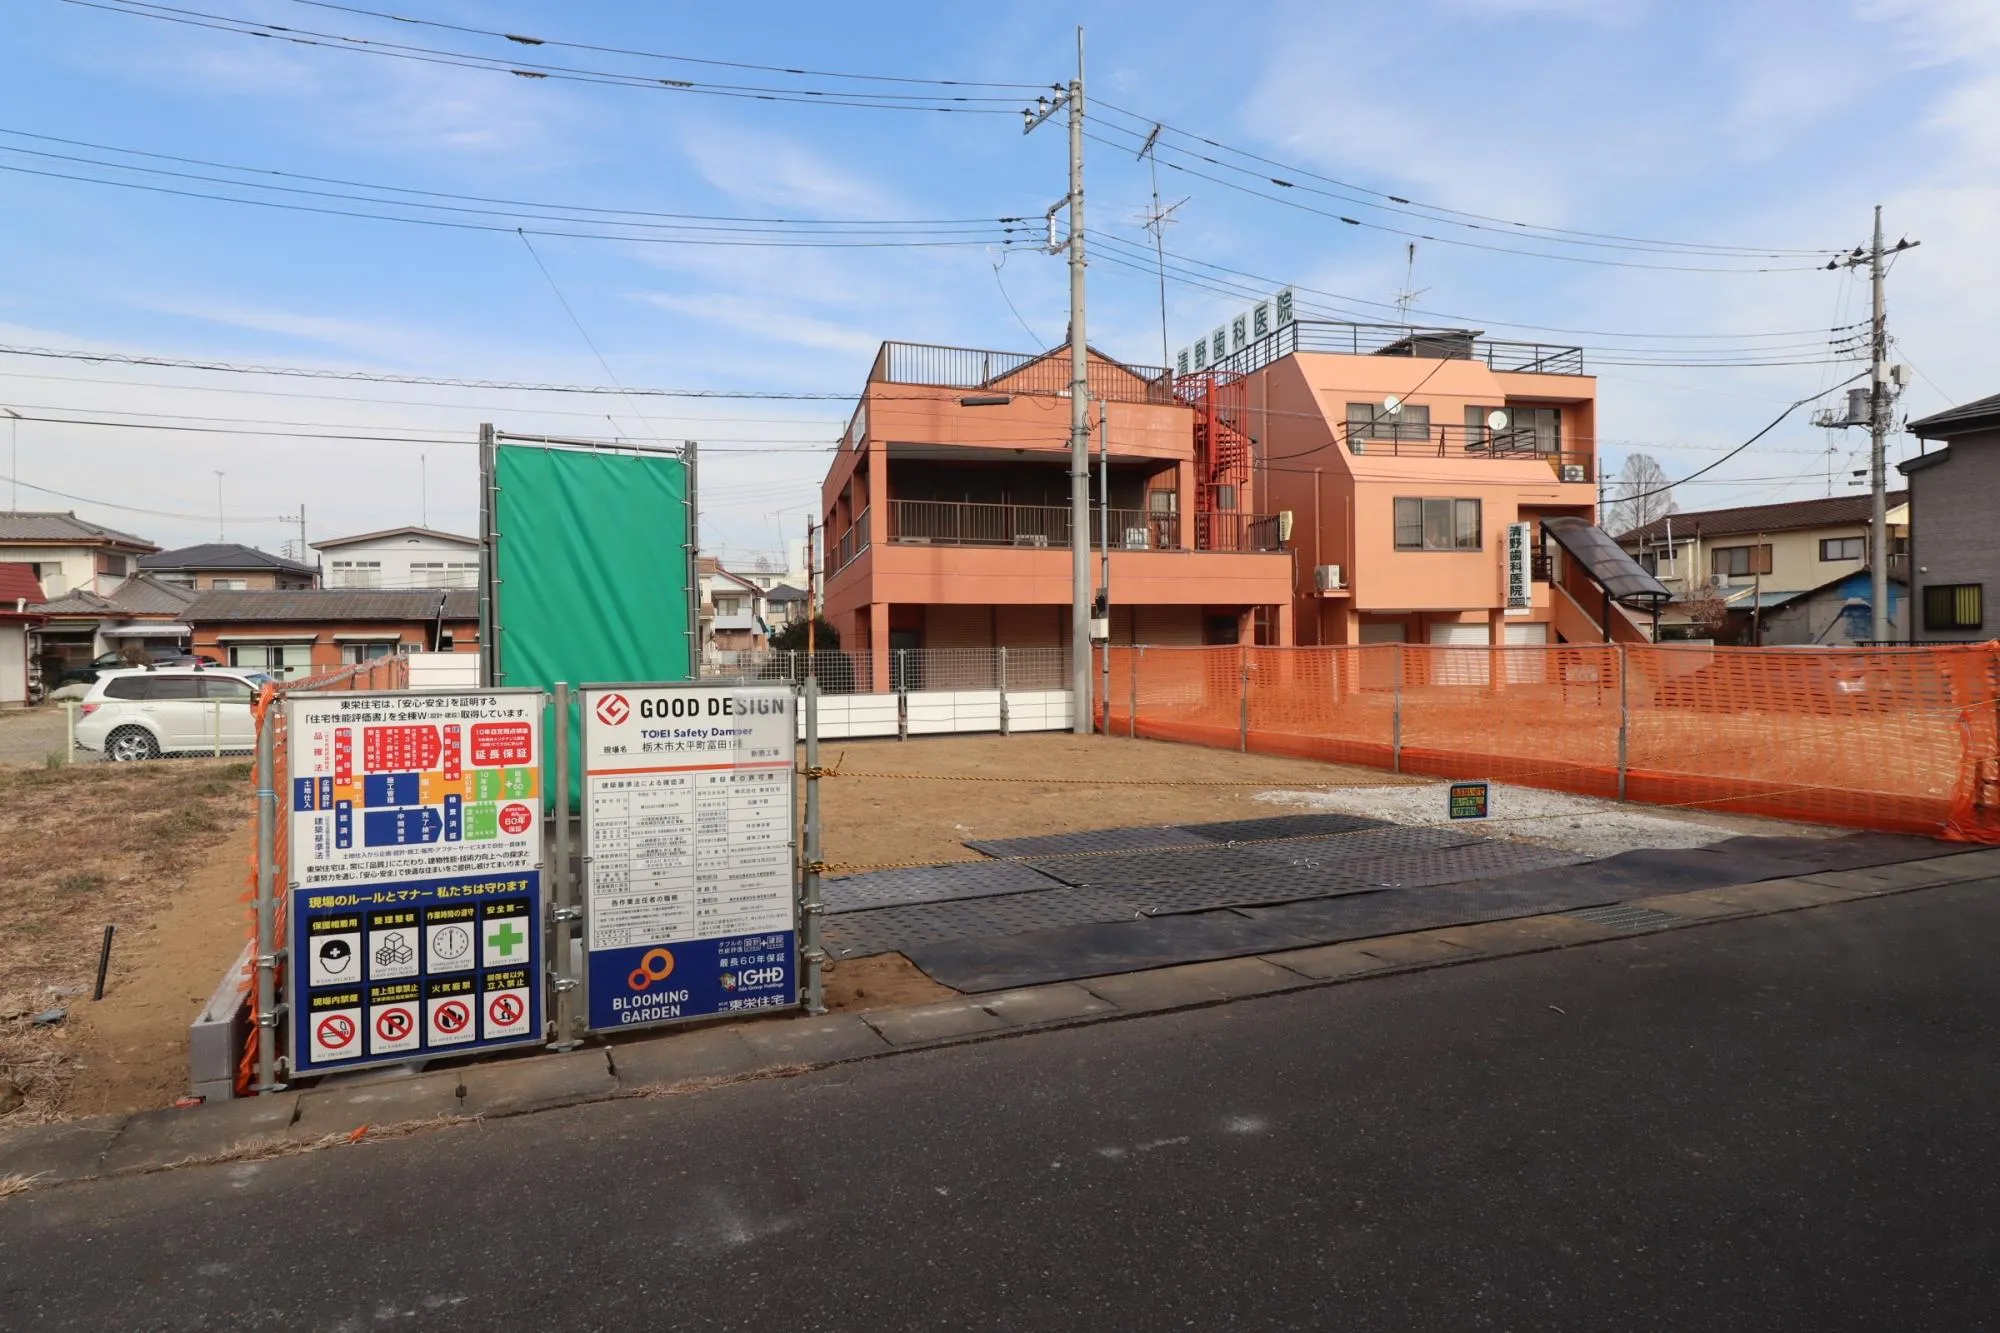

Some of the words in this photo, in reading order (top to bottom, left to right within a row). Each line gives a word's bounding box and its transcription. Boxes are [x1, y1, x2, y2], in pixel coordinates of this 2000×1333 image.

[341, 697, 497, 710] 東栄住宅は、「安心・安全」を証明する
[640, 698, 700, 719] GOOD
[708, 696, 785, 717] DESIGN
[674, 728, 708, 740] Safety
[475, 748, 528, 760] 延長保証
[603, 745, 628, 754] 現場名
[304, 779, 312, 808] 土地仕入
[308, 889, 433, 909] 現場のルールとマナー
[436, 879, 529, 899] 私たちは守ります
[486, 904, 525, 915] 安全第一
[374, 913, 415, 926] 整理整頓
[720, 953, 785, 968] 最長60年保証
[738, 966, 784, 986] IGHD
[487, 978, 525, 990] 立入禁止
[612, 989, 689, 1011] BLOOMING
[729, 994, 785, 1011] 東栄住宅
[621, 1004, 681, 1024] GARDEN
